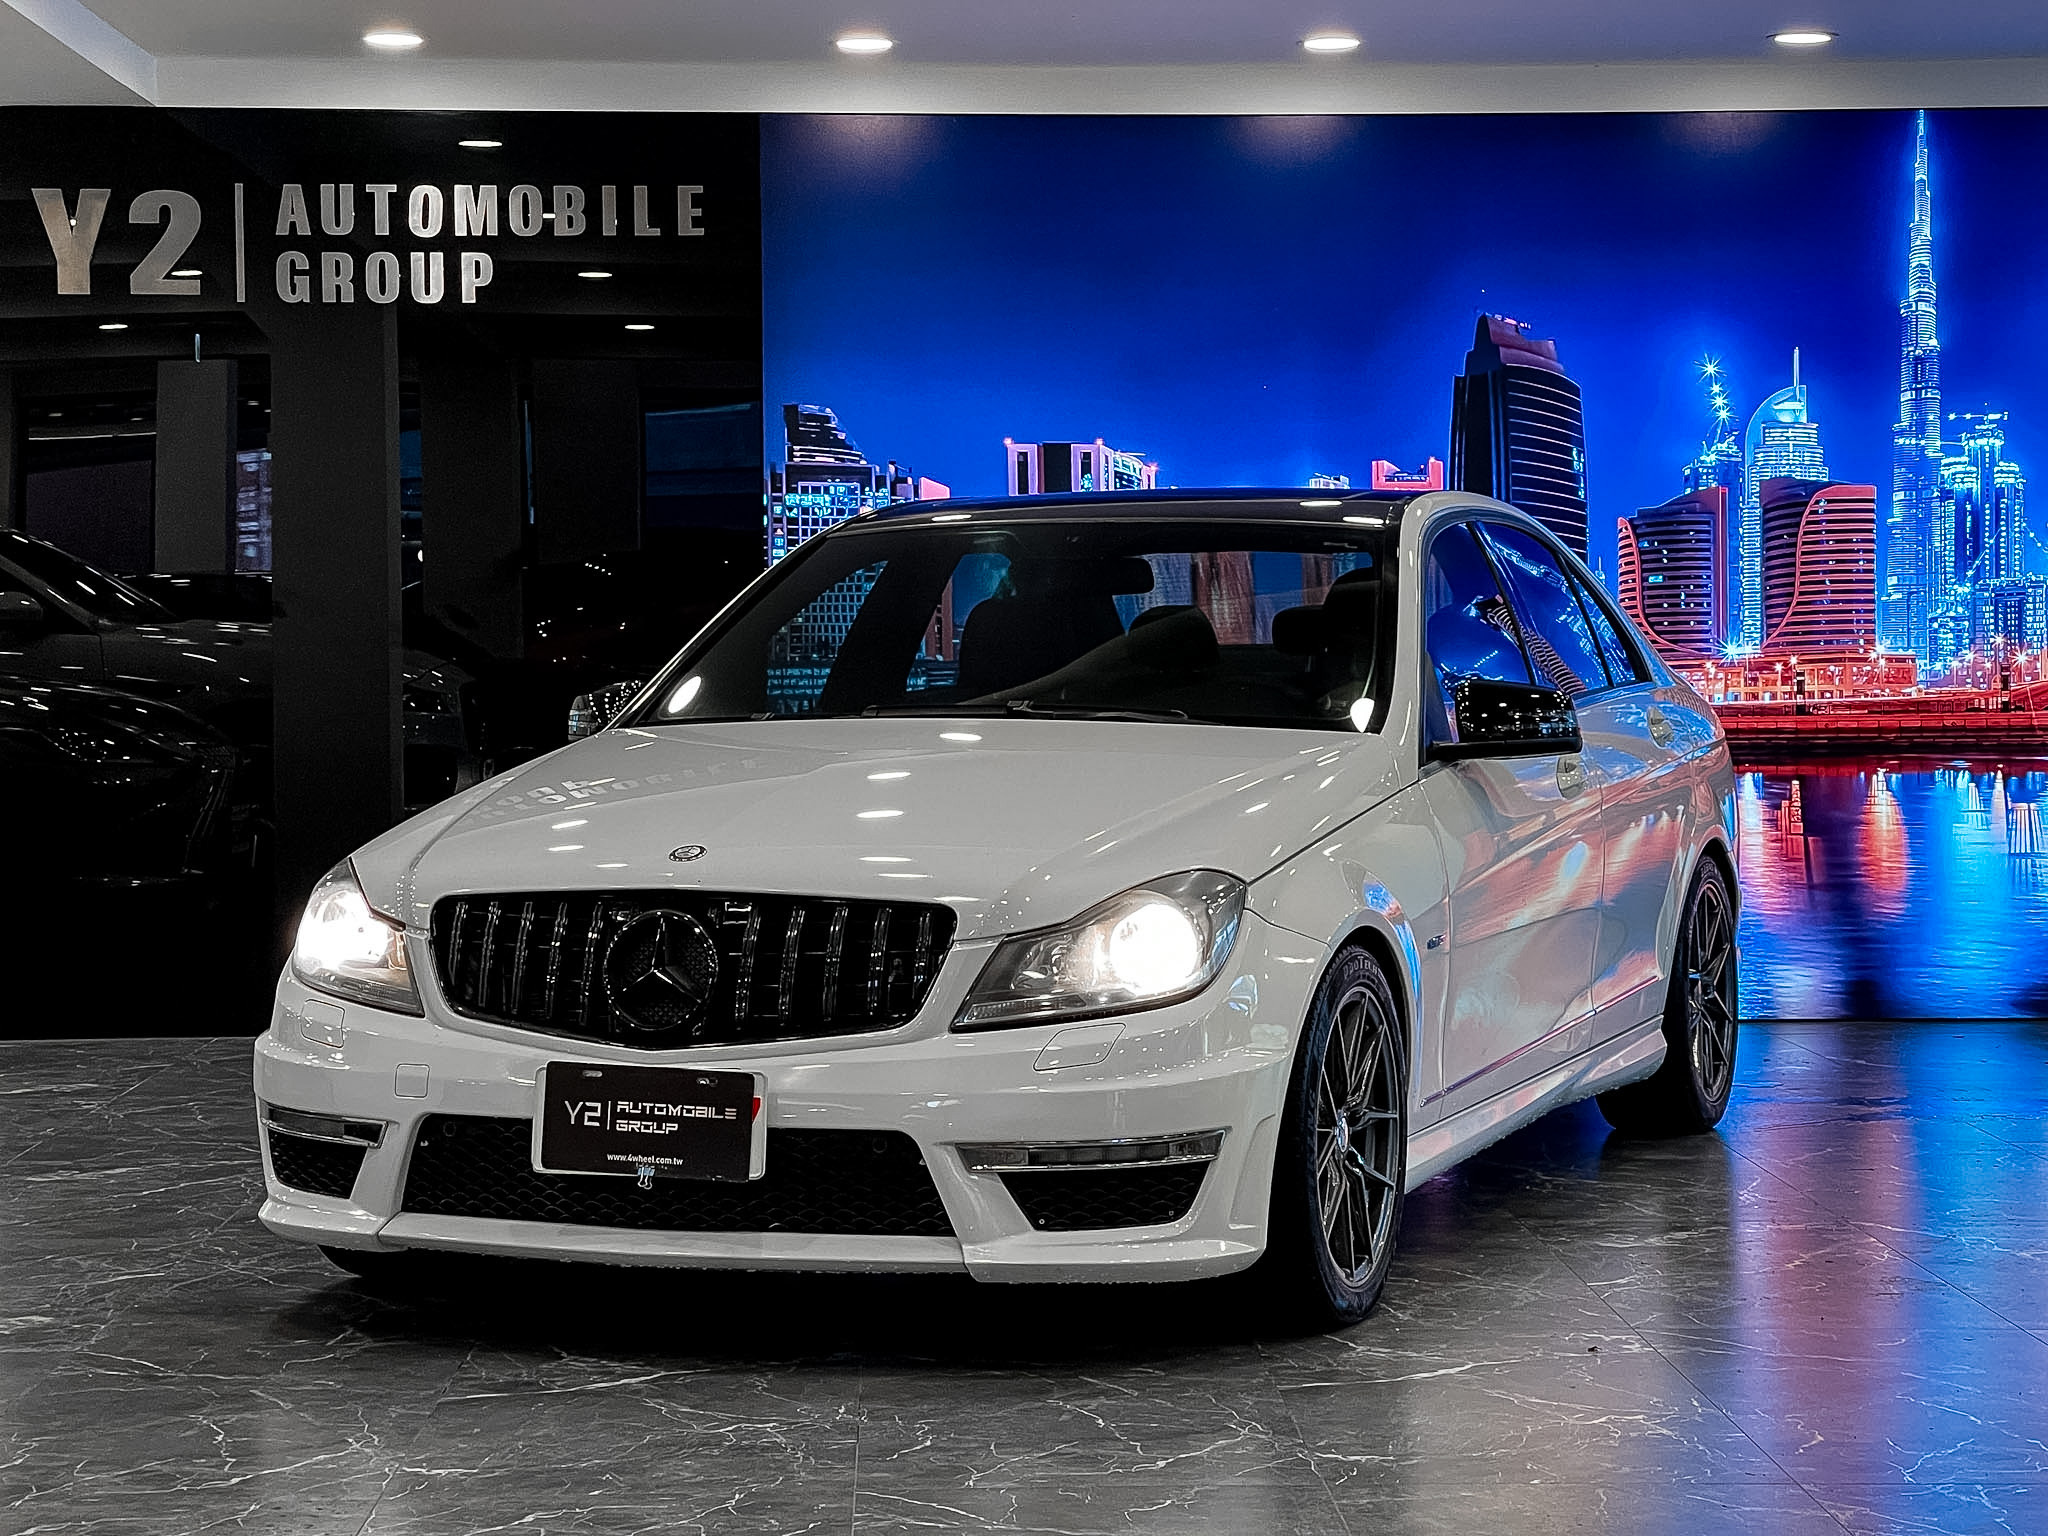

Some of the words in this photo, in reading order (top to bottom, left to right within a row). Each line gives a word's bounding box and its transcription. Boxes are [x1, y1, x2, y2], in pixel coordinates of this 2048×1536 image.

[275, 183, 706, 238] AUTOMOBILE
[31, 188, 202, 295] Y2
[275, 251, 494, 304] GROUP
[564, 1100, 601, 1127] Y2
[616, 1101, 737, 1119] AUTOMOBILE
[616, 1120, 679, 1134] GROUP
[606, 1153, 684, 1166] www.4wheel.com.tw
